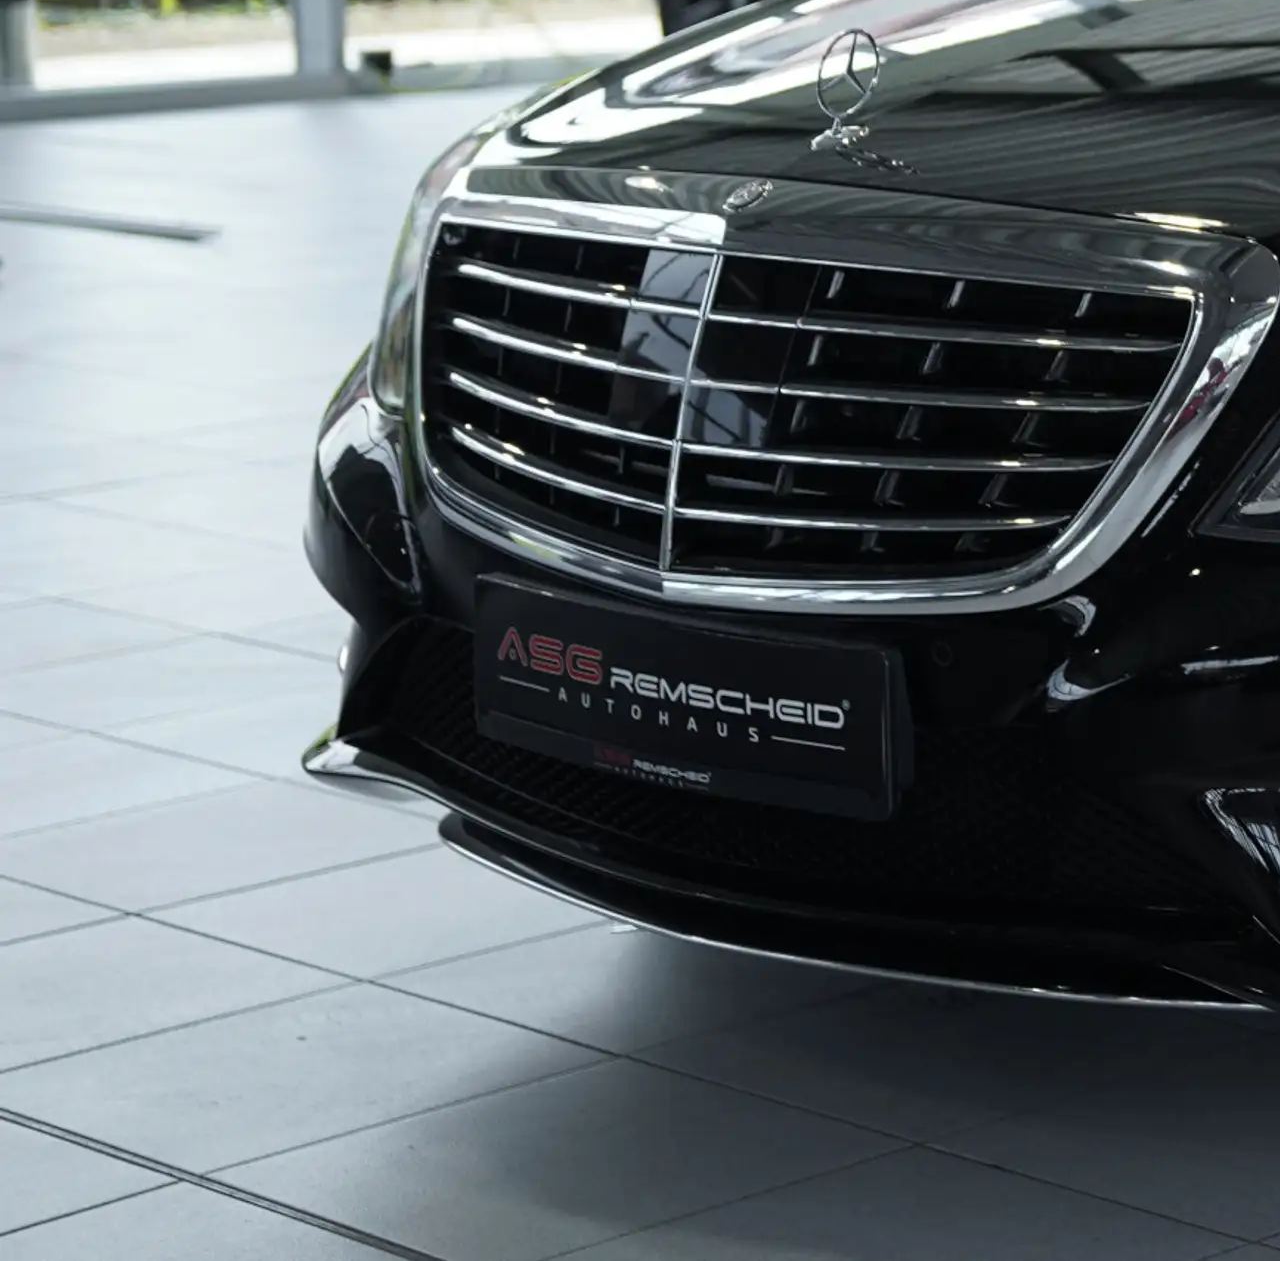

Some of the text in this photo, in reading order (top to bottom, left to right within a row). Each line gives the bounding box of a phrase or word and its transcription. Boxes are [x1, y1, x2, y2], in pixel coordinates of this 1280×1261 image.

[497, 626, 845, 730] ASG REMSCHEID
[558, 687, 759, 743] AUTOHAUS
